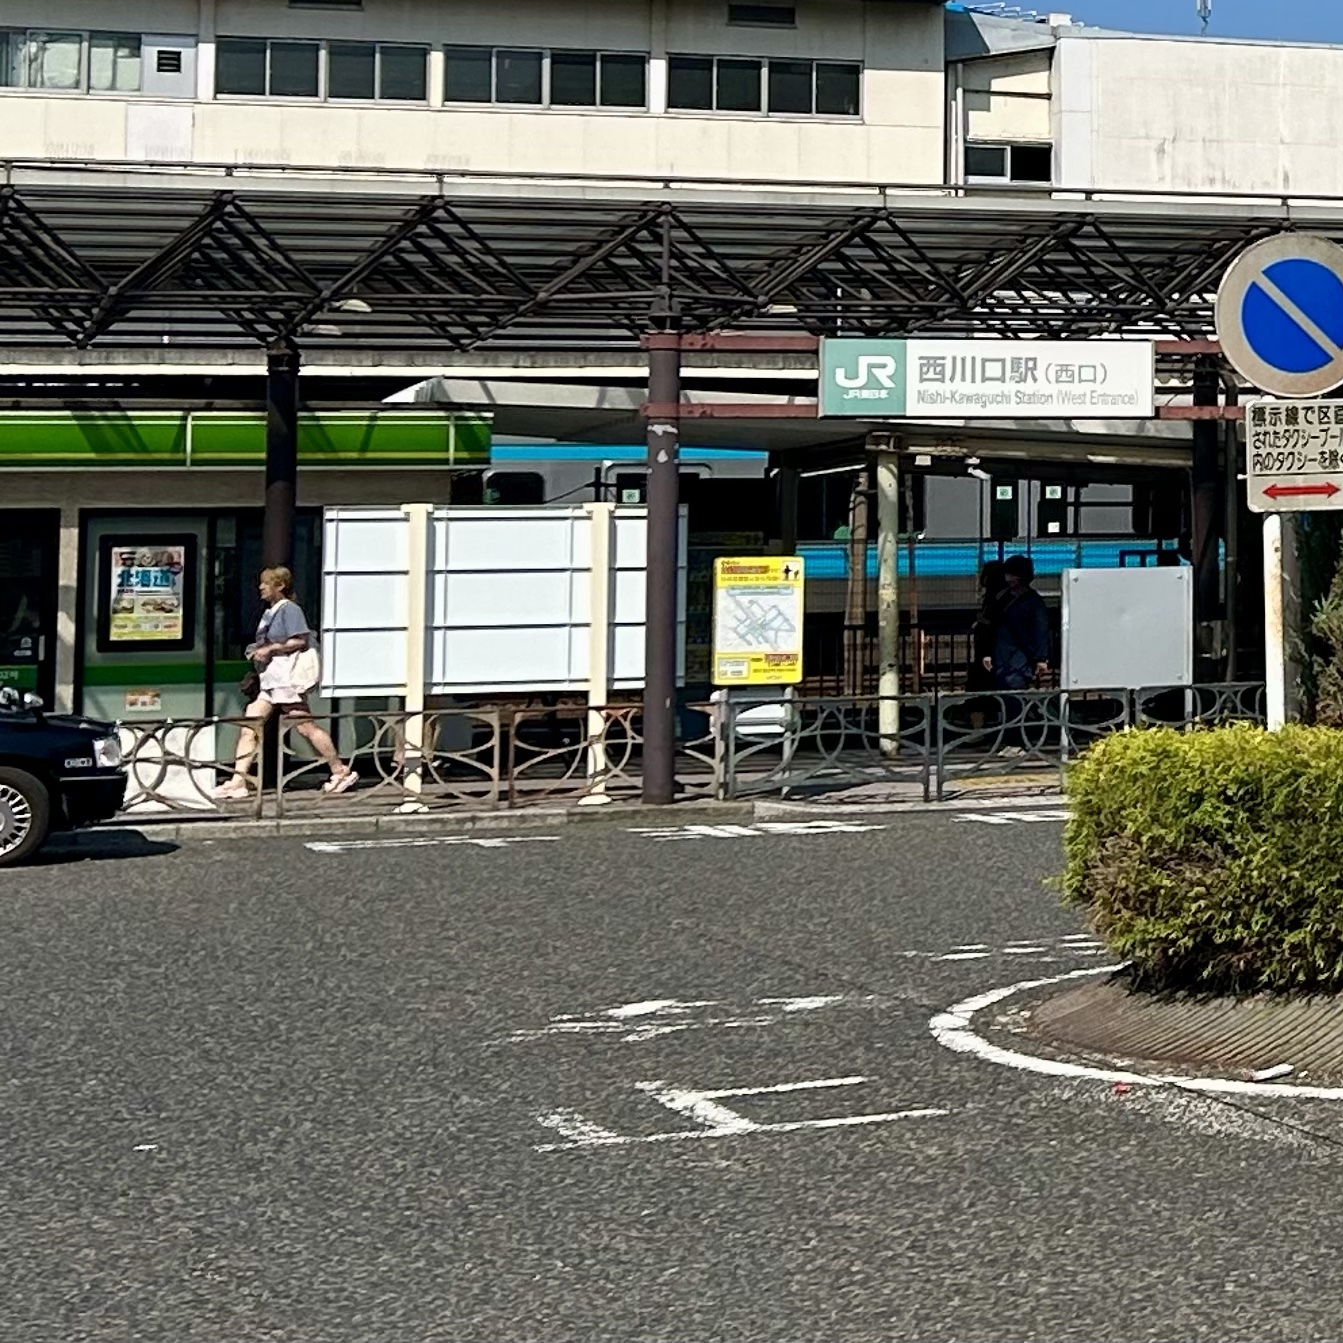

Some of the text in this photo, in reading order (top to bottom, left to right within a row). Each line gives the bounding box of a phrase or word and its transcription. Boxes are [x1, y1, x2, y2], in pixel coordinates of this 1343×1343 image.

[835, 355, 897, 388] JR
[917, 389, 1139, 408] Nishi-Kawaguchi Station (West Entrance)
